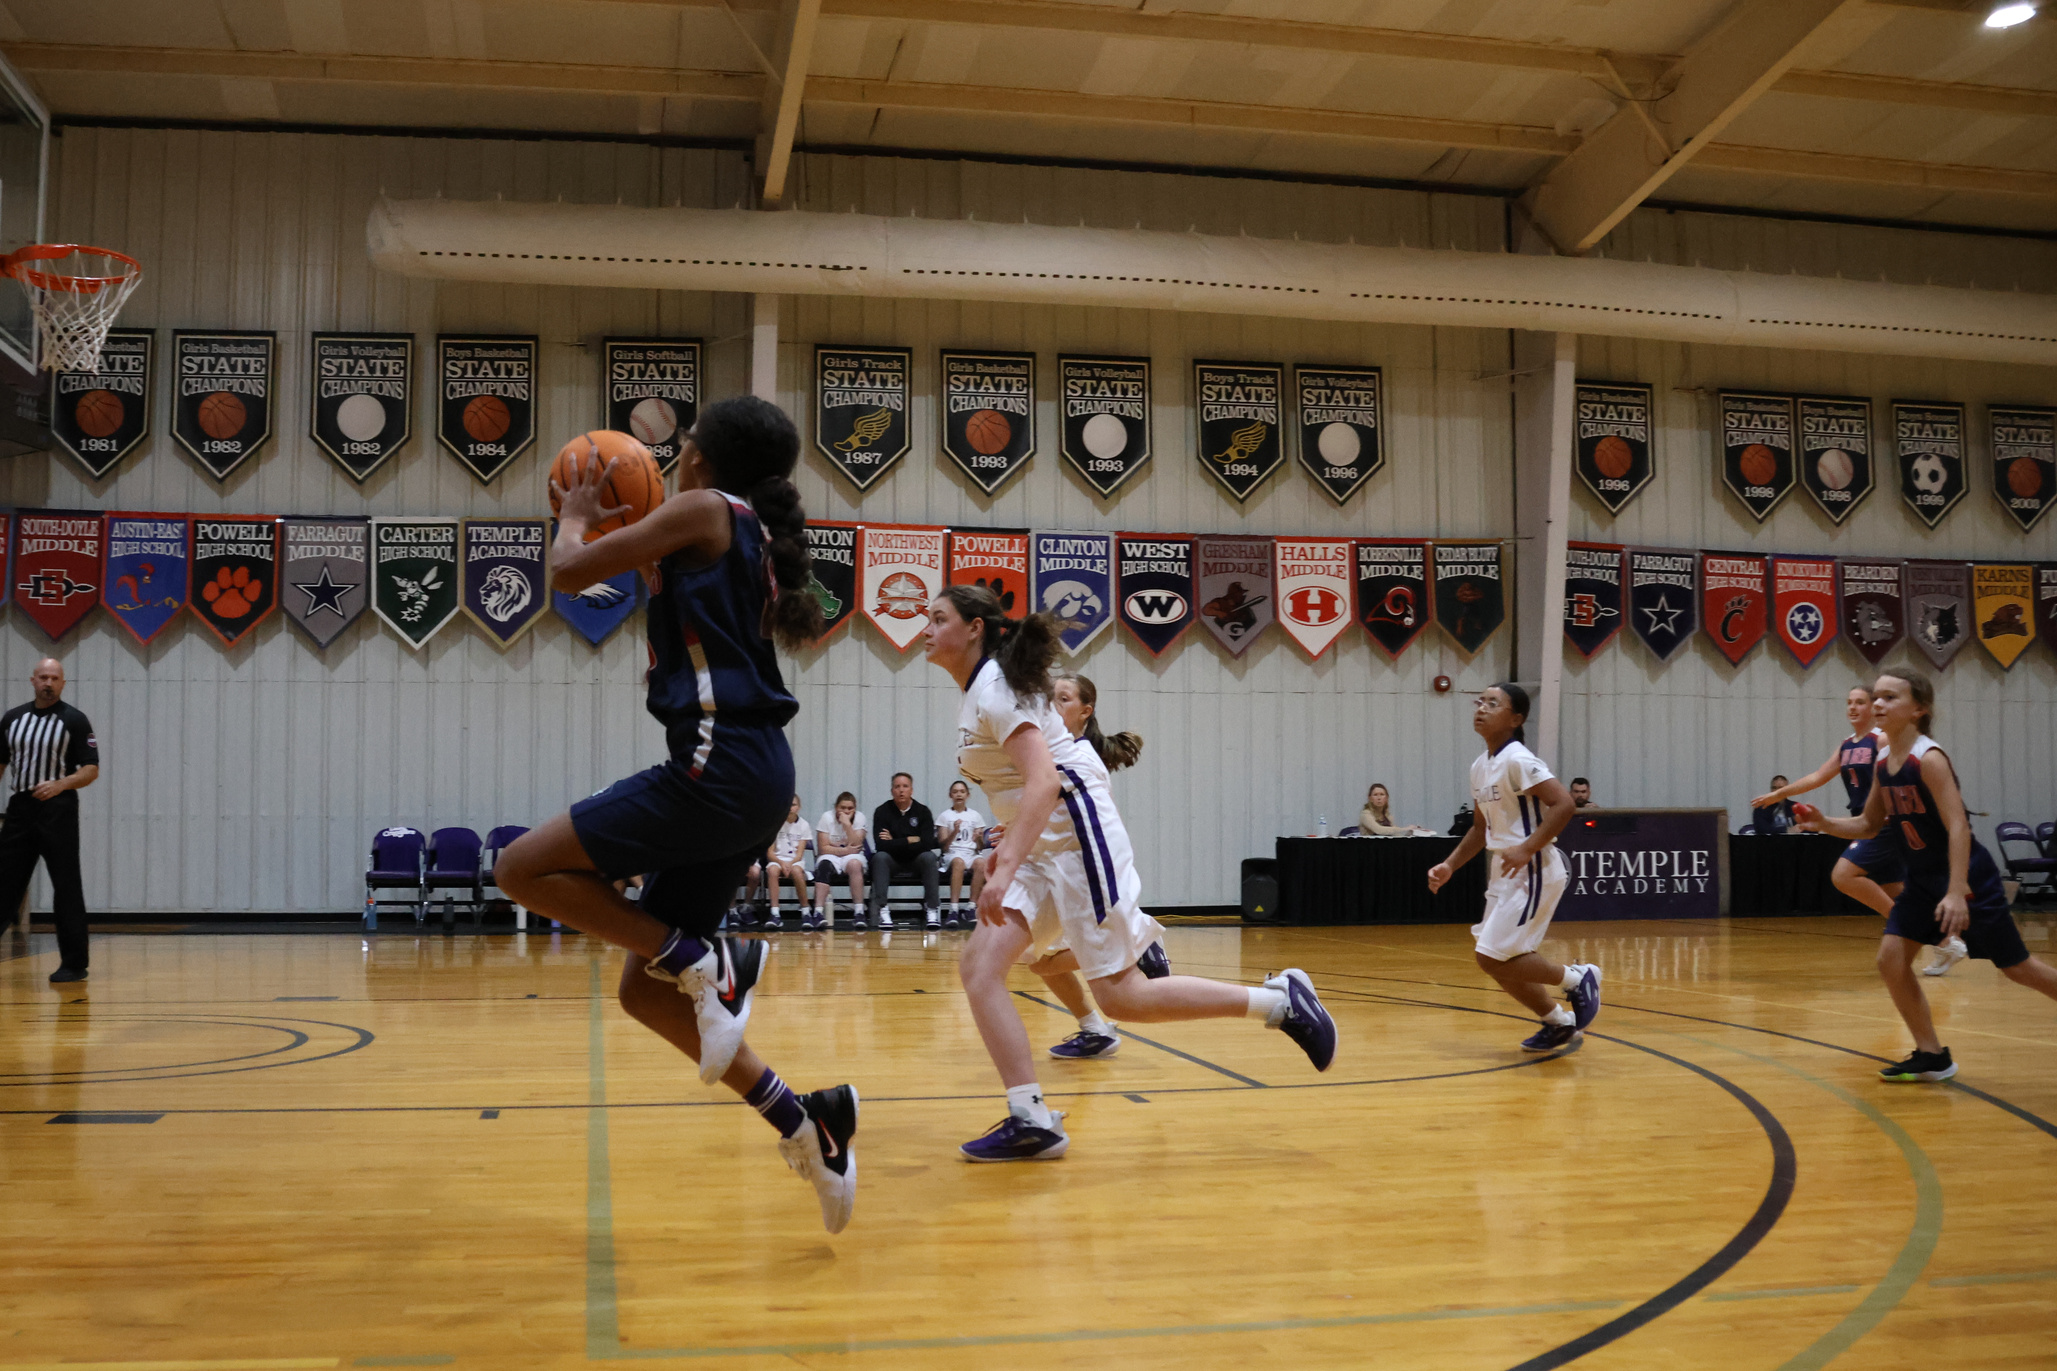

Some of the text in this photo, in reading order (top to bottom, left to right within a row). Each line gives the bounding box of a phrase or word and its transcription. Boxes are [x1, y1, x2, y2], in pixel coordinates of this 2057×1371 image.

[182, 343, 267, 355] Girls Basketball
[321, 346, 406, 359] Girls Volleyball
[446, 348, 529, 360] Boys Basketball
[613, 350, 693, 361] Girls Softball
[182, 356, 266, 375] STATE
[321, 359, 404, 377] STATE
[446, 360, 529, 378] STATE
[613, 363, 694, 380] STATE
[824, 358, 902, 370] Girls Track
[949, 362, 1027, 375] Girls Basketball
[824, 371, 902, 388] STATE
[1065, 367, 1144, 380] Girls Volleyball
[1203, 373, 1275, 386] Boys Track
[60, 376, 144, 396] CHAMPIONS
[182, 378, 265, 397] CHAMPIONS
[321, 380, 404, 399] CHAMPIONS
[446, 382, 529, 400] CHAMPIONS
[949, 375, 1027, 394] STATE
[1066, 380, 1143, 398] STATE
[1301, 377, 1374, 390] Girls Volleyball
[613, 384, 694, 403] CHAMPIONS
[824, 391, 903, 411] CHAMPIONS
[1202, 385, 1276, 403] STATE
[1302, 389, 1374, 407] STATE
[950, 396, 1028, 416] CHAMPIONS
[1067, 400, 1143, 420] CHAMPIONS
[1580, 403, 1646, 421] STATE
[1203, 406, 1277, 425] CHAMPIONS
[1303, 409, 1375, 428] CHAMPIONS
[1725, 411, 1788, 430] STATE
[1580, 423, 1646, 442] CHAMPIONS
[1803, 416, 1865, 434] STATE
[1898, 421, 1958, 439] STATE
[1725, 432, 1789, 451] CHAMPIONS
[1994, 426, 2053, 444] STATE
[80, 440, 118, 452] 1981
[202, 441, 242, 453] 1982
[342, 443, 380, 455] 1982
[468, 444, 507, 456] 1984
[1804, 436, 1866, 455] CHAMPIONS
[1900, 441, 1959, 459] CHAMPIONS
[1996, 445, 2054, 463] CHAMPIONS
[844, 452, 882, 465] 1987
[970, 456, 1007, 469] 1993
[1087, 460, 1124, 472] 1993
[1223, 464, 1259, 476] 1994
[1323, 467, 1358, 479] 1996
[1744, 487, 1775, 499] 1998
[21, 519, 98, 537] SOUTH-DOYLE
[111, 522, 185, 539] AUSTIN-EAST
[196, 524, 274, 540] POWELL
[288, 525, 365, 542] FARRAGUT
[380, 526, 454, 543] CARTER
[468, 526, 542, 543] TEMPLE
[20, 539, 98, 557] MIDDLE
[110, 541, 185, 559] HIGH SCHOOL
[868, 532, 939, 551] NORTHWEST
[953, 536, 1025, 554] POWELL
[1039, 538, 1106, 556] CLINTON
[196, 543, 273, 561] HIGH SCHOOL
[288, 545, 365, 562] MIDDLE
[379, 546, 455, 563] HIGH SCHOOL
[468, 546, 541, 562] ACADEMY
[810, 549, 854, 567] SCHOOL
[1122, 543, 1190, 559] WEST
[1202, 543, 1268, 560] GRESHAM
[1280, 546, 1346, 561] HALLS
[866, 552, 938, 569] MIDDLE
[953, 555, 1025, 573] MIDDLE
[1039, 557, 1107, 575] MIDDLE
[1633, 555, 1693, 571] FARRAGUT
[1706, 559, 1764, 575] CENTRAL
[1121, 561, 1190, 578] HIGH SCHOOL
[1202, 562, 1268, 578] MIDDLE
[1281, 564, 1346, 580] MIDDLE
[1360, 564, 1424, 580] MIDDLE
[1436, 564, 1499, 580] MIDDLE
[1583, 568, 1619, 585] SCHOOL
[1976, 568, 2029, 582] KARNS
[1633, 572, 1693, 590] HIGH SCHOOL
[1705, 576, 1764, 593] HIGH SCHOOL
[1976, 586, 2029, 599] MIDDLE
[1571, 850, 1710, 878] TEMPLE
[1574, 878, 1709, 895] ACADEMY
